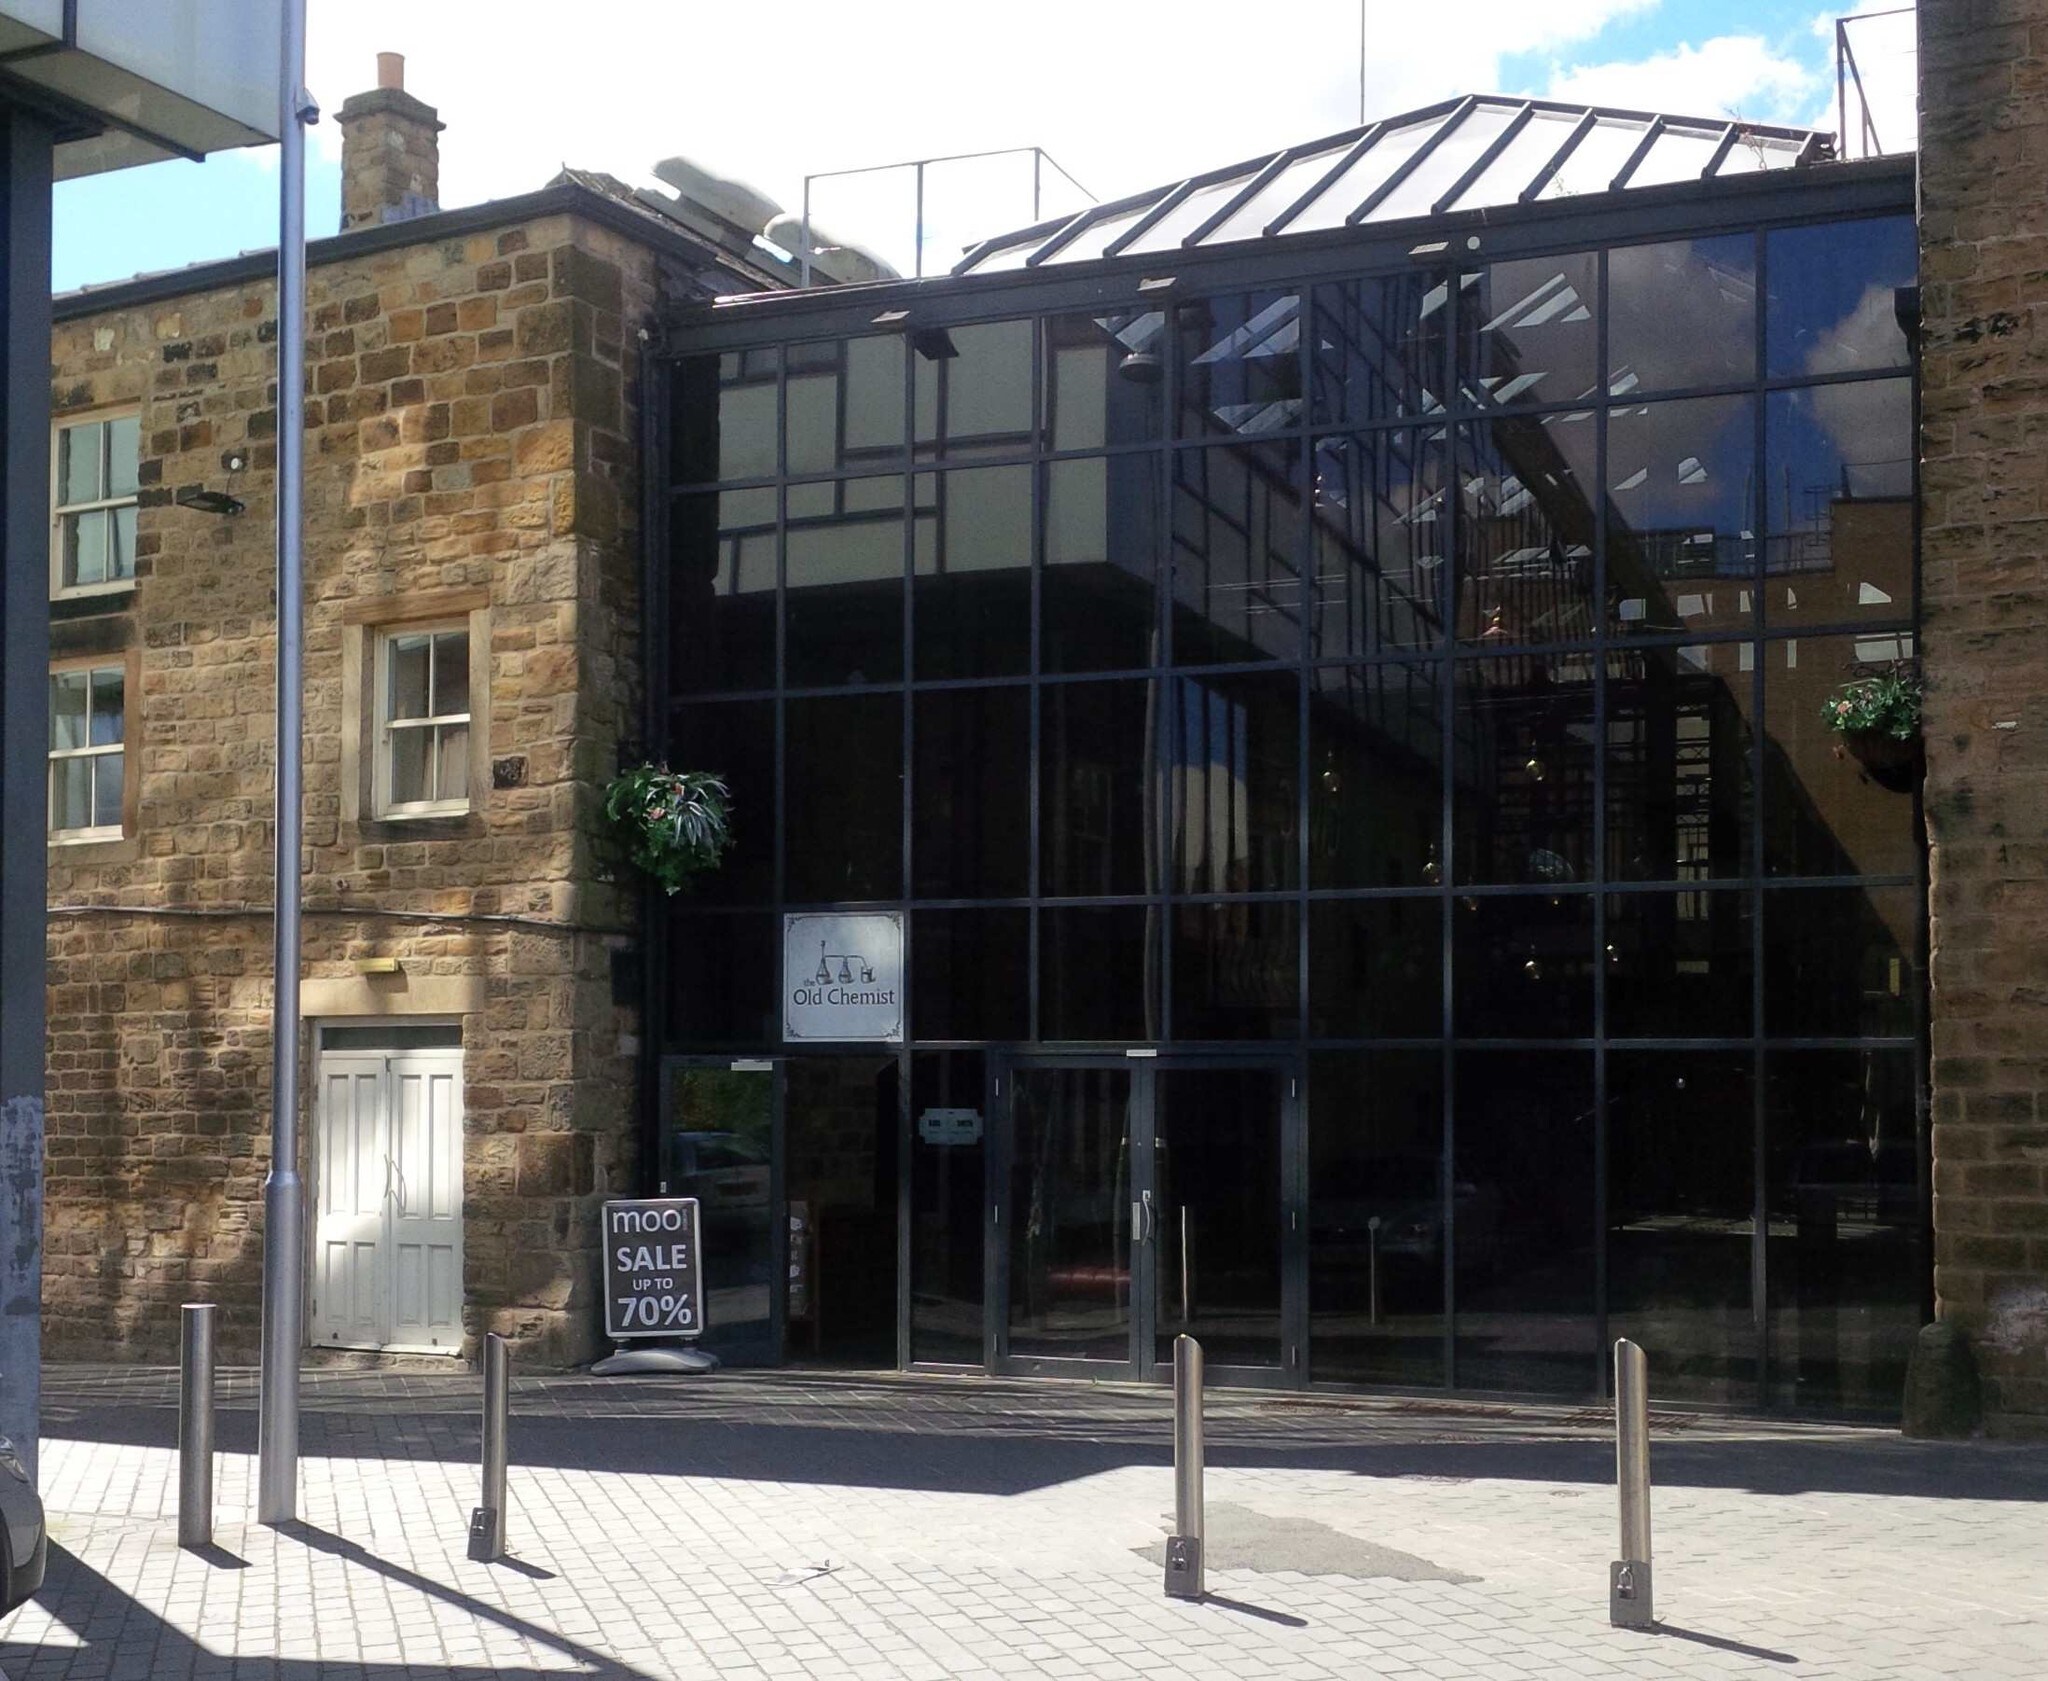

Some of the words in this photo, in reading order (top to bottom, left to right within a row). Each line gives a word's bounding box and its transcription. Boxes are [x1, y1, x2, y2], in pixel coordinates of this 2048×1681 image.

[803, 978, 816, 987] the
[793, 988, 822, 1005] Old
[827, 987, 895, 1005] Chemist
[613, 1209, 681, 1233] moo
[617, 1244, 687, 1272] SALE
[633, 1279, 651, 1291] UP
[654, 1278, 673, 1290] TO
[617, 1294, 692, 1328] 70%
